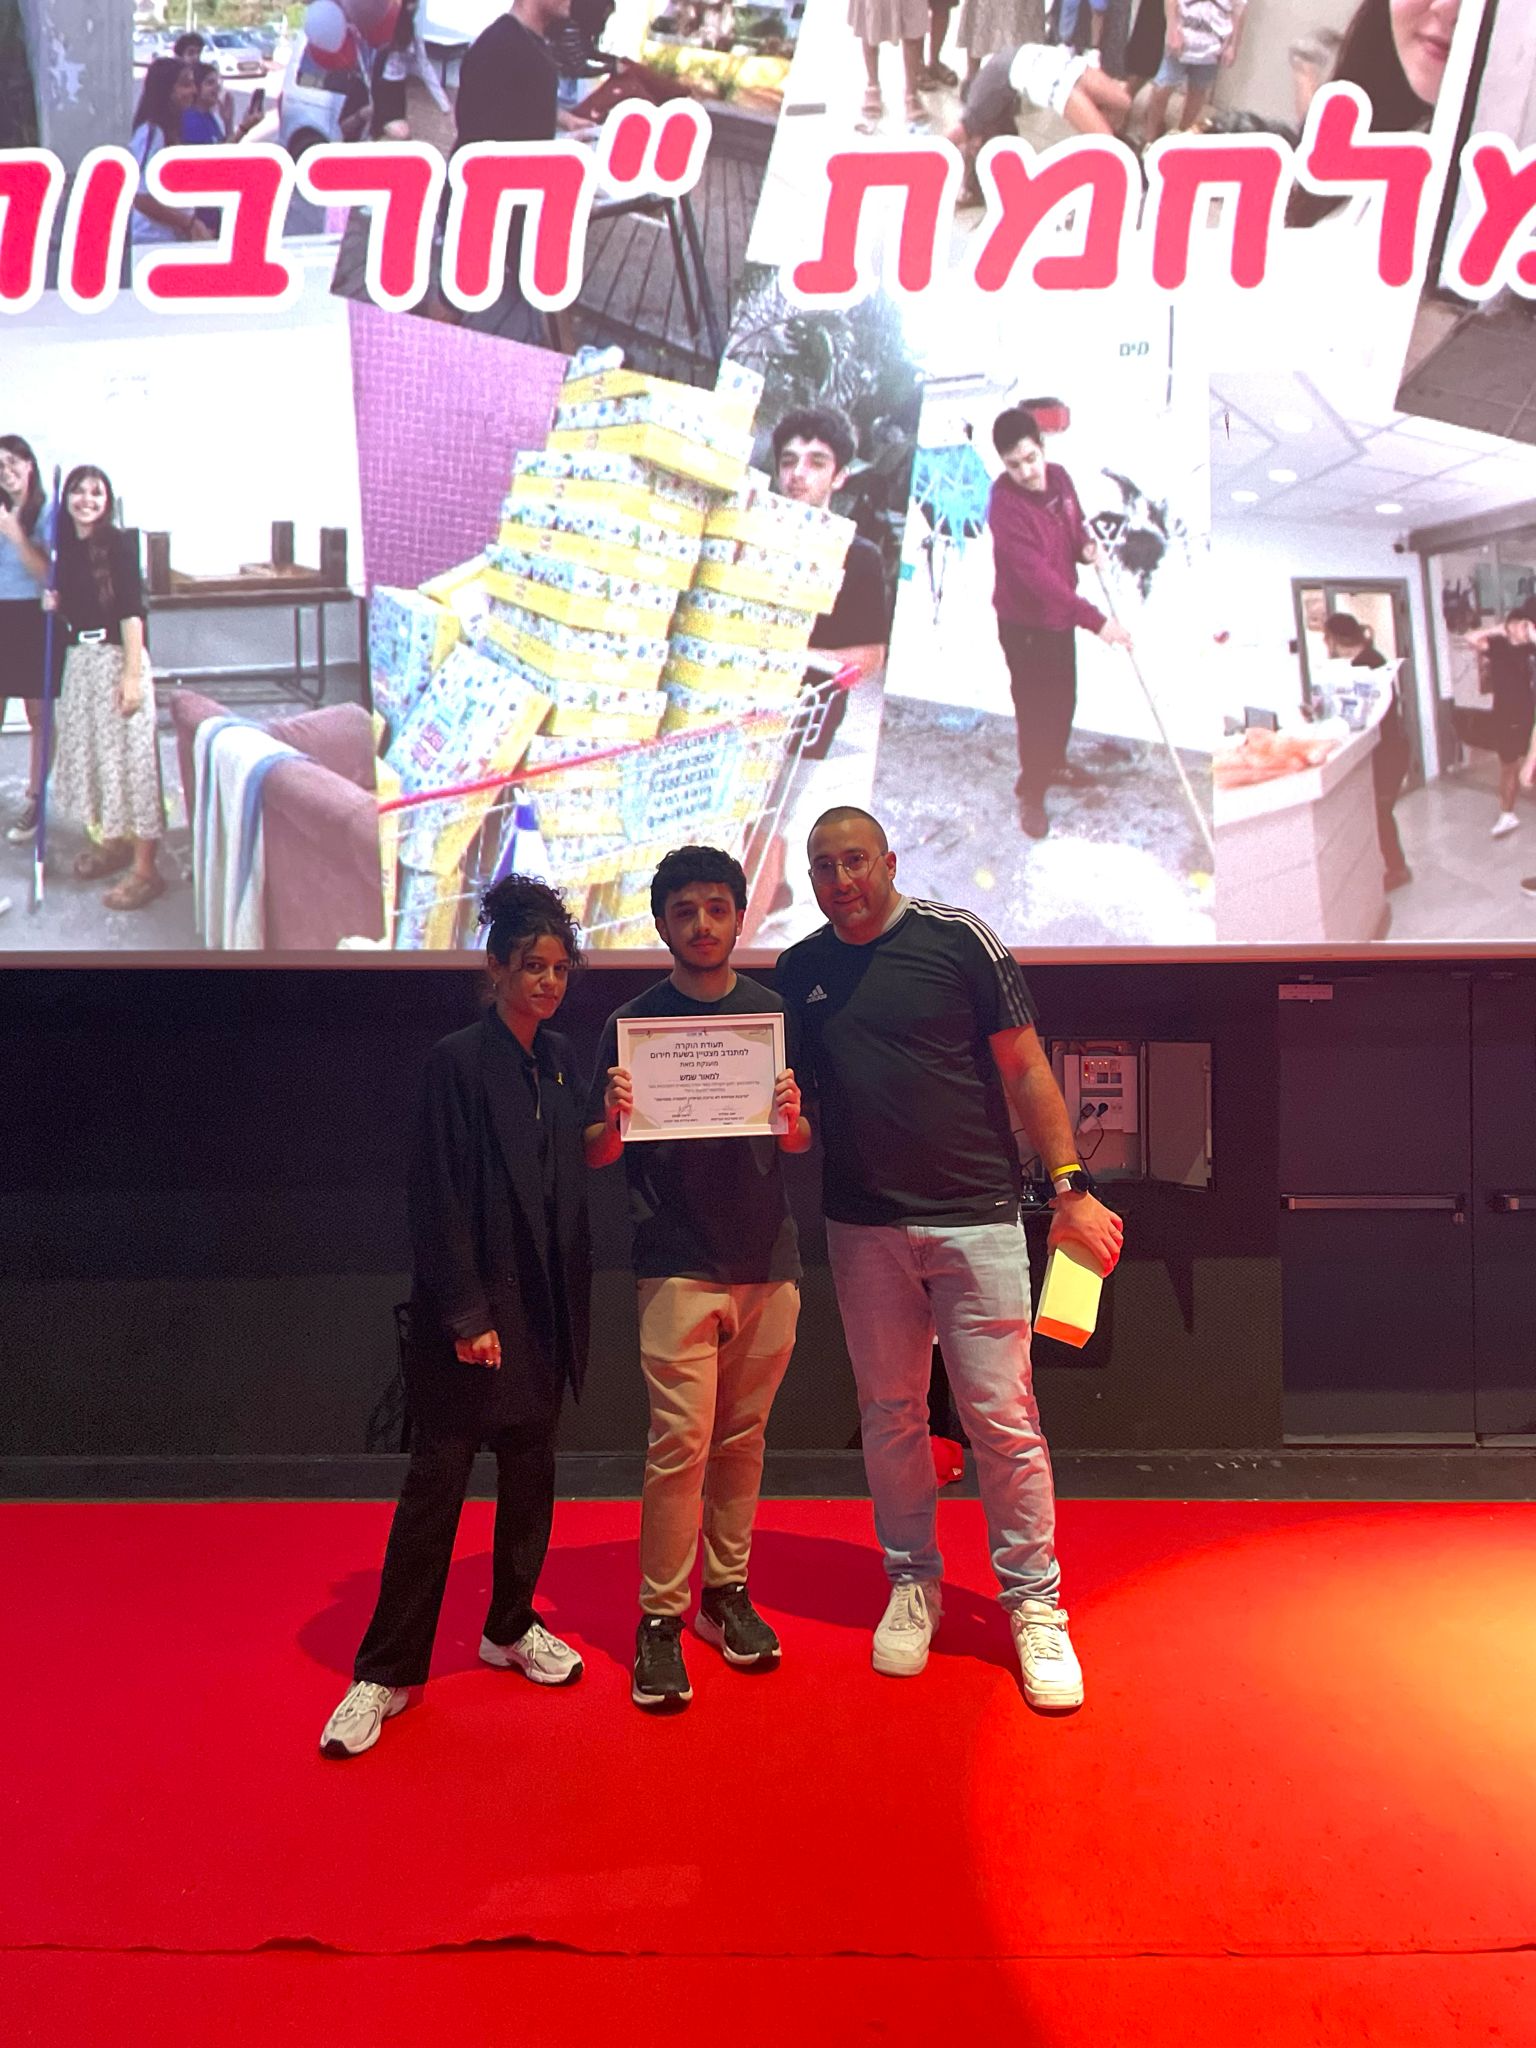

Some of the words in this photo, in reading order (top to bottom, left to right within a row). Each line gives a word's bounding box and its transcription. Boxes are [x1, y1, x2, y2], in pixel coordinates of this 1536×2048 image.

[675, 1042, 698, 1050] הוקרה
[696, 1050, 719, 1058] מצטיין
[720, 1048, 749, 1056] למתנדב
[696, 1060, 719, 1068] מוענקת
